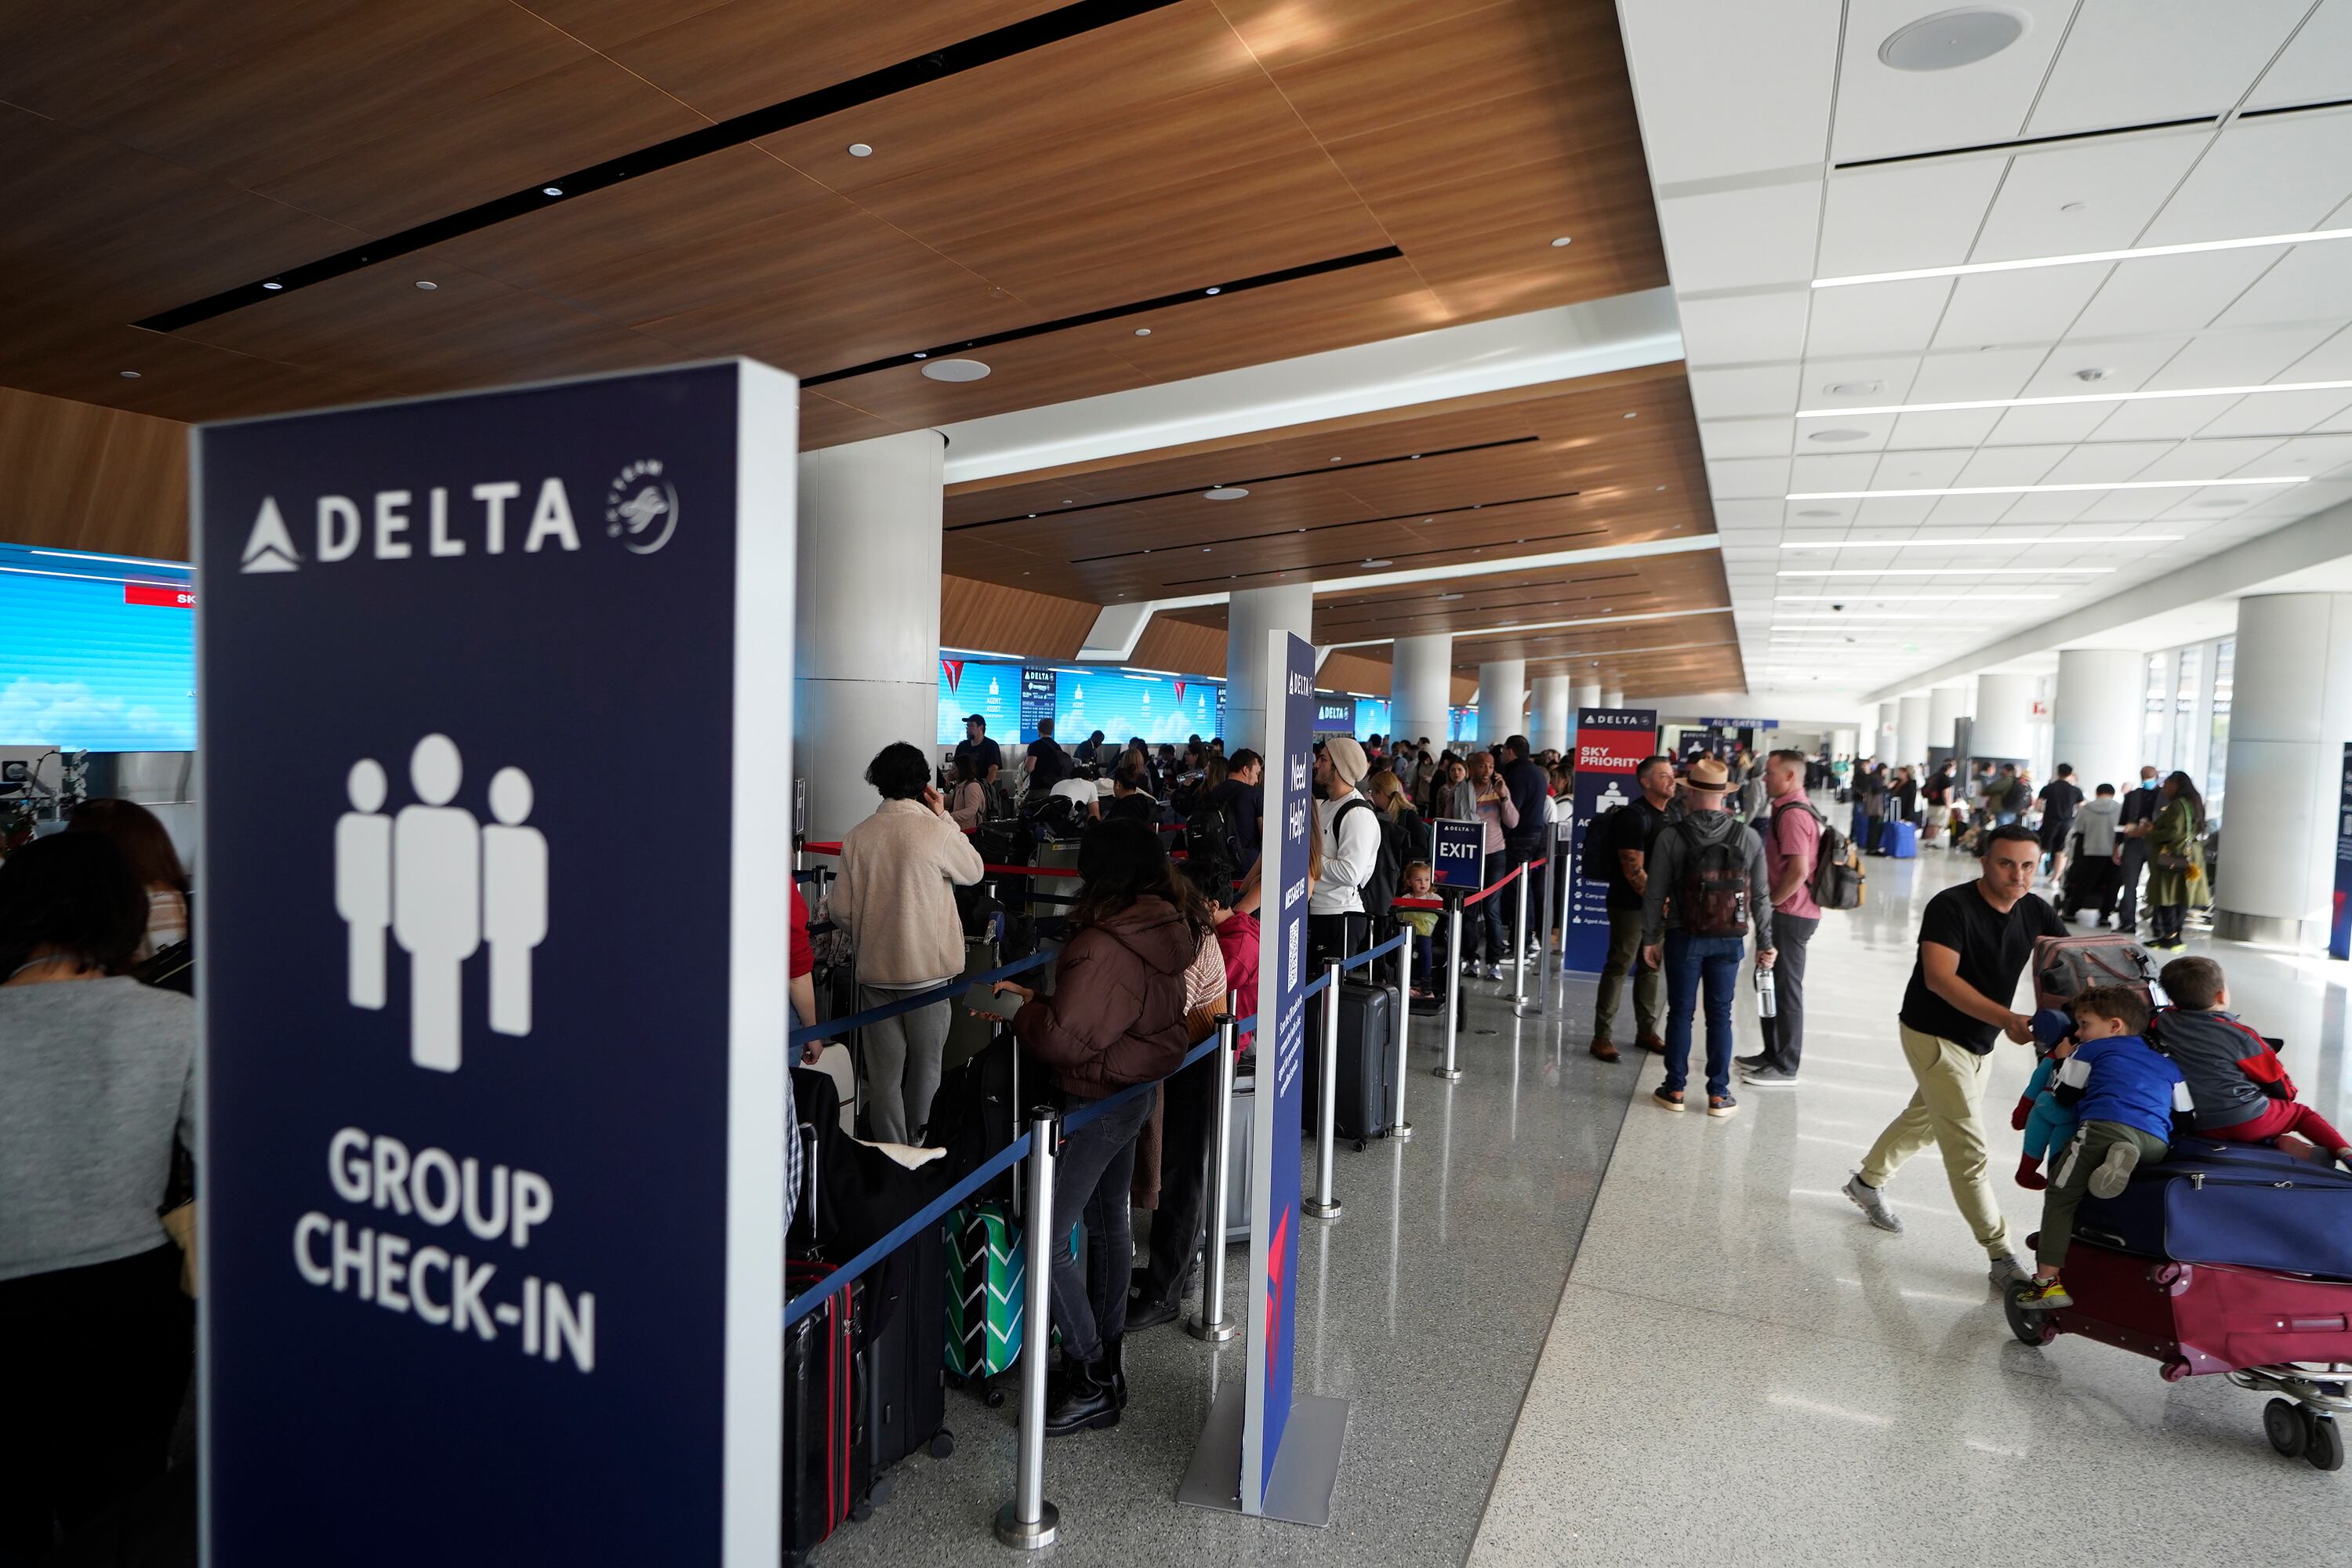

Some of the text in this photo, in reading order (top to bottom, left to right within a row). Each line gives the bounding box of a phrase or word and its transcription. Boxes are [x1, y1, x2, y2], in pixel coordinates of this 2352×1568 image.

[317, 477, 581, 562] DELTA
[1030, 671, 1049, 681] DELTA
[1294, 673, 1308, 697] DELTA
[1325, 706, 1344, 719] DELTA
[1598, 715, 1638, 724] DELTA
[1581, 746, 1609, 757] SKY
[1290, 752, 1307, 792] Need
[1289, 797, 1306, 845] Help?
[1439, 842, 1478, 859] EXIT
[328, 1126, 554, 1249] GROUP
[293, 1210, 596, 1374] CHECK-IN
